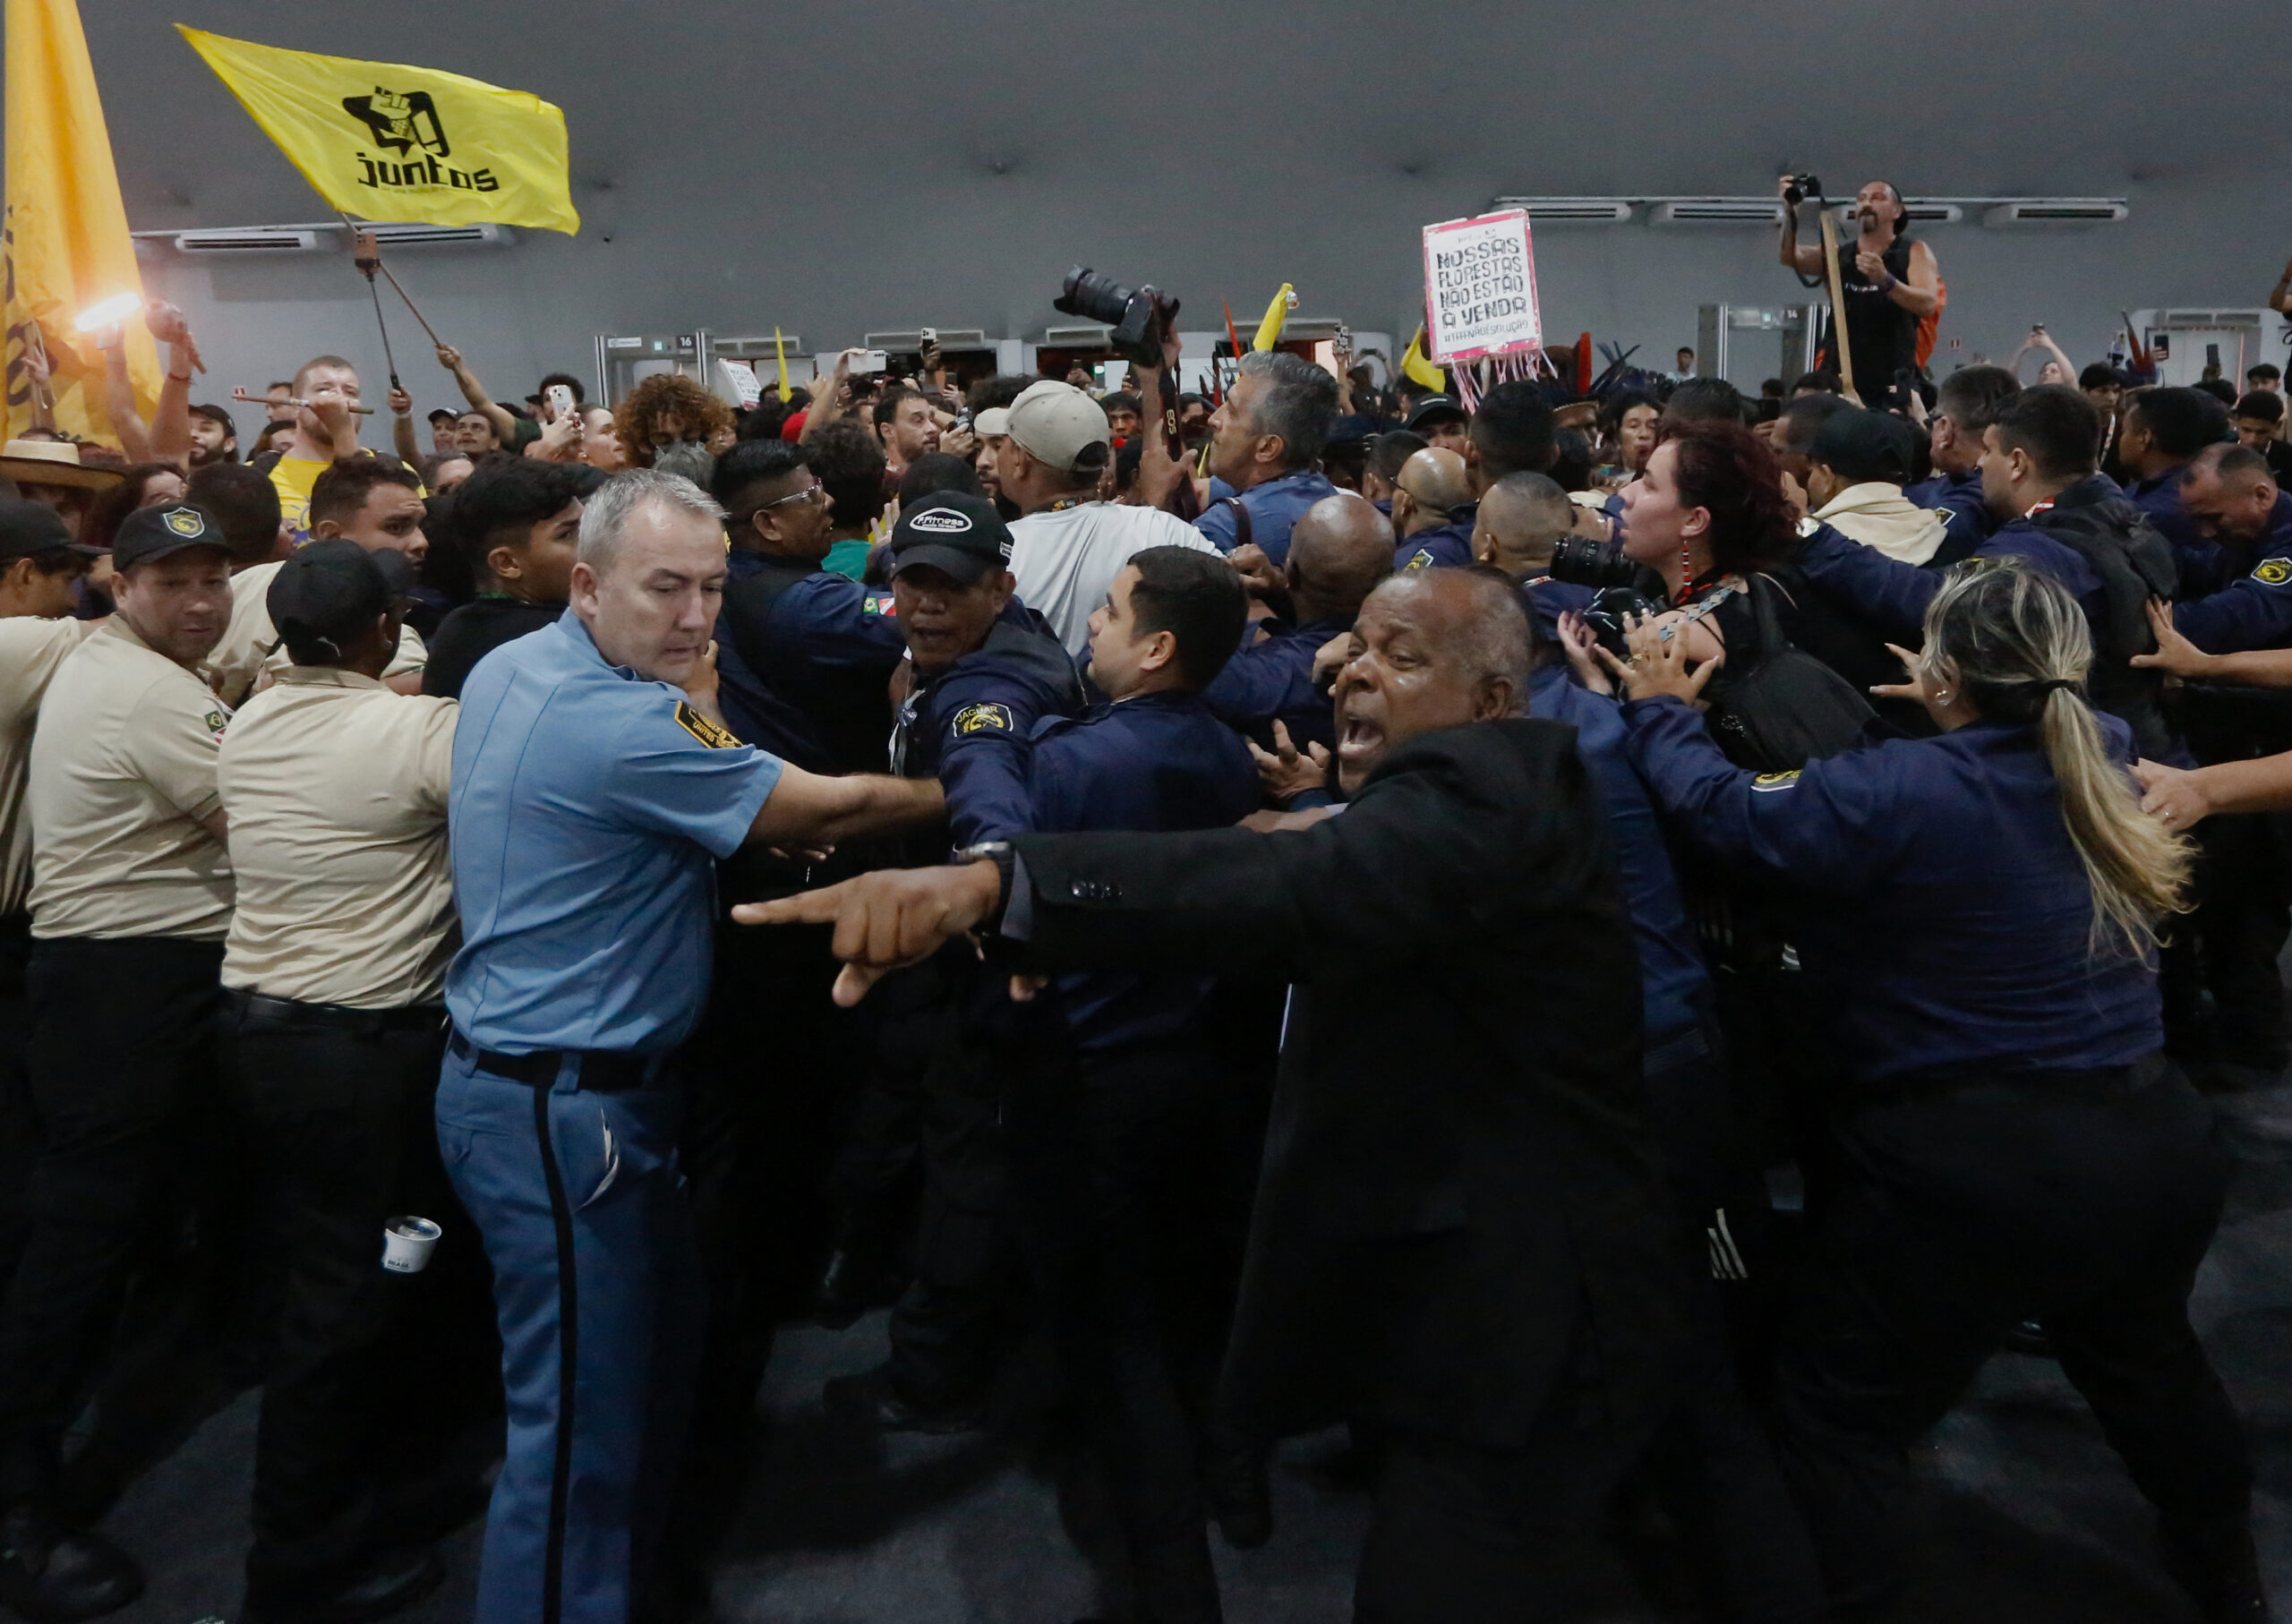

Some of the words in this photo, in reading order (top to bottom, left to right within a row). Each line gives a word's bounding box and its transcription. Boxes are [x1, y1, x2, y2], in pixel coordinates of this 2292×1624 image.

[356, 152, 500, 192] juntos
[1436, 237, 1520, 269] NOSSAS
[1438, 256, 1523, 288] FLORESTAS
[1440, 287, 1470, 309] NÃO
[1473, 273, 1525, 301] ESTÃO
[1461, 296, 1527, 327] VENDA
[680, 337, 692, 346] 16
[1166, 408, 1177, 435] EOS
[958, 705, 998, 722] JAGUAR
[693, 722, 715, 742] UNITED
